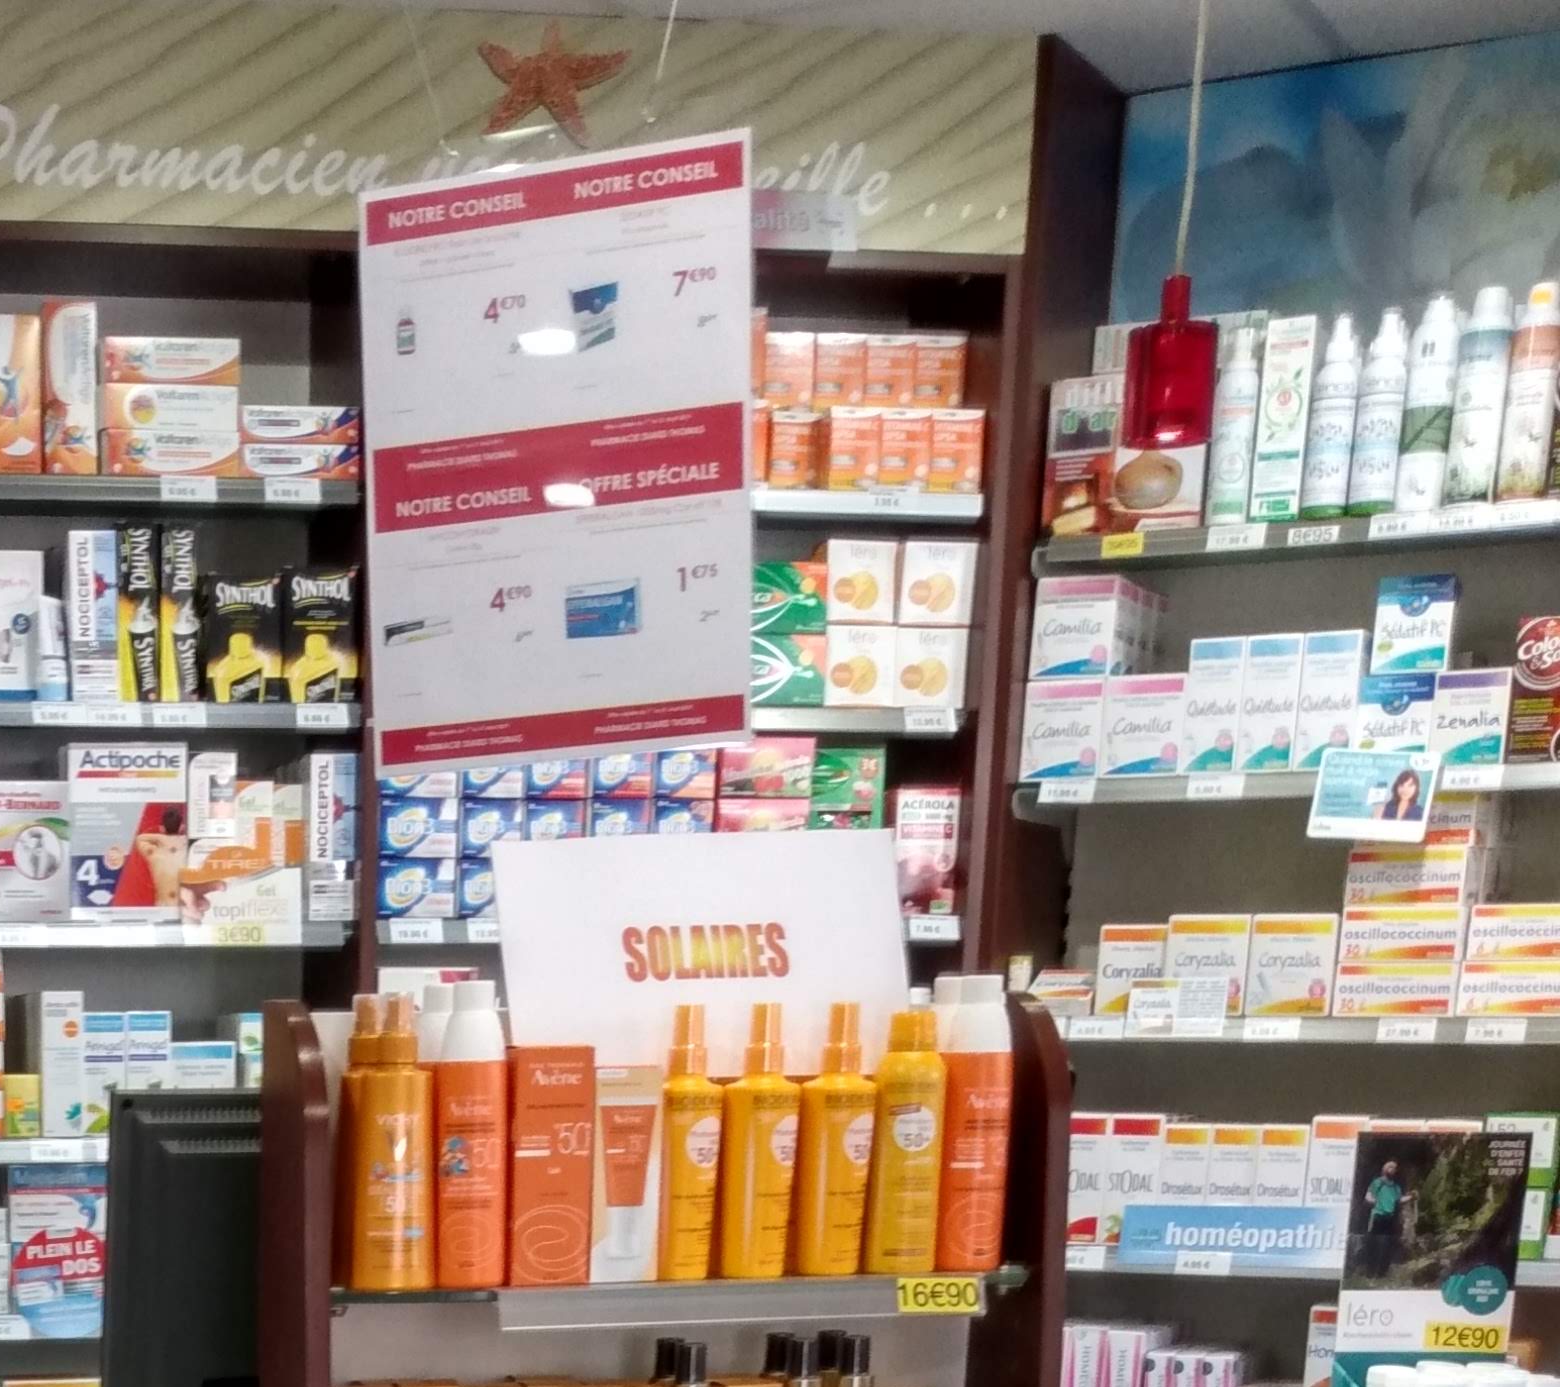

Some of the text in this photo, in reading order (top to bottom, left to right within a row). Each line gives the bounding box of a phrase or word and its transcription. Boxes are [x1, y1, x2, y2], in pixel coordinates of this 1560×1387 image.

[574, 161, 717, 199] NOTRE CONSEIL
[389, 192, 525, 228] NOTRE CONSEIL
[579, 462, 719, 493] OFFRE SPÉCIALE
[396, 487, 531, 517] NOTRE CONSEIL
[1292, 528, 1333, 544] 8€95
[77, 536, 90, 639] NOCICEPTOL
[215, 580, 276, 608] SYNTHOL
[290, 577, 353, 604] SYNTHOL
[1043, 618, 1102, 637] Camilia
[1032, 721, 1090, 740] Camilia
[1112, 717, 1172, 735] Camilia
[79, 751, 181, 771] Actipoche
[318, 759, 329, 858] NOCICEPTOL
[77, 861, 99, 885] 4
[1350, 870, 1461, 887] oscillococcinum
[1345, 927, 1457, 943] oscillococcinum
[622, 921, 789, 982] SOLAIRES
[1176, 951, 1236, 970] Coryzalia
[1259, 951, 1320, 971] Coryzalia
[1340, 983, 1450, 996] oscillococcinum
[27, 1239, 95, 1259] PLEIN LE
[62, 1257, 100, 1275] DOS
[900, 1282, 979, 1309] 16€90
[1347, 1302, 1393, 1326] léro
[1431, 1326, 1498, 1349] 12€90
